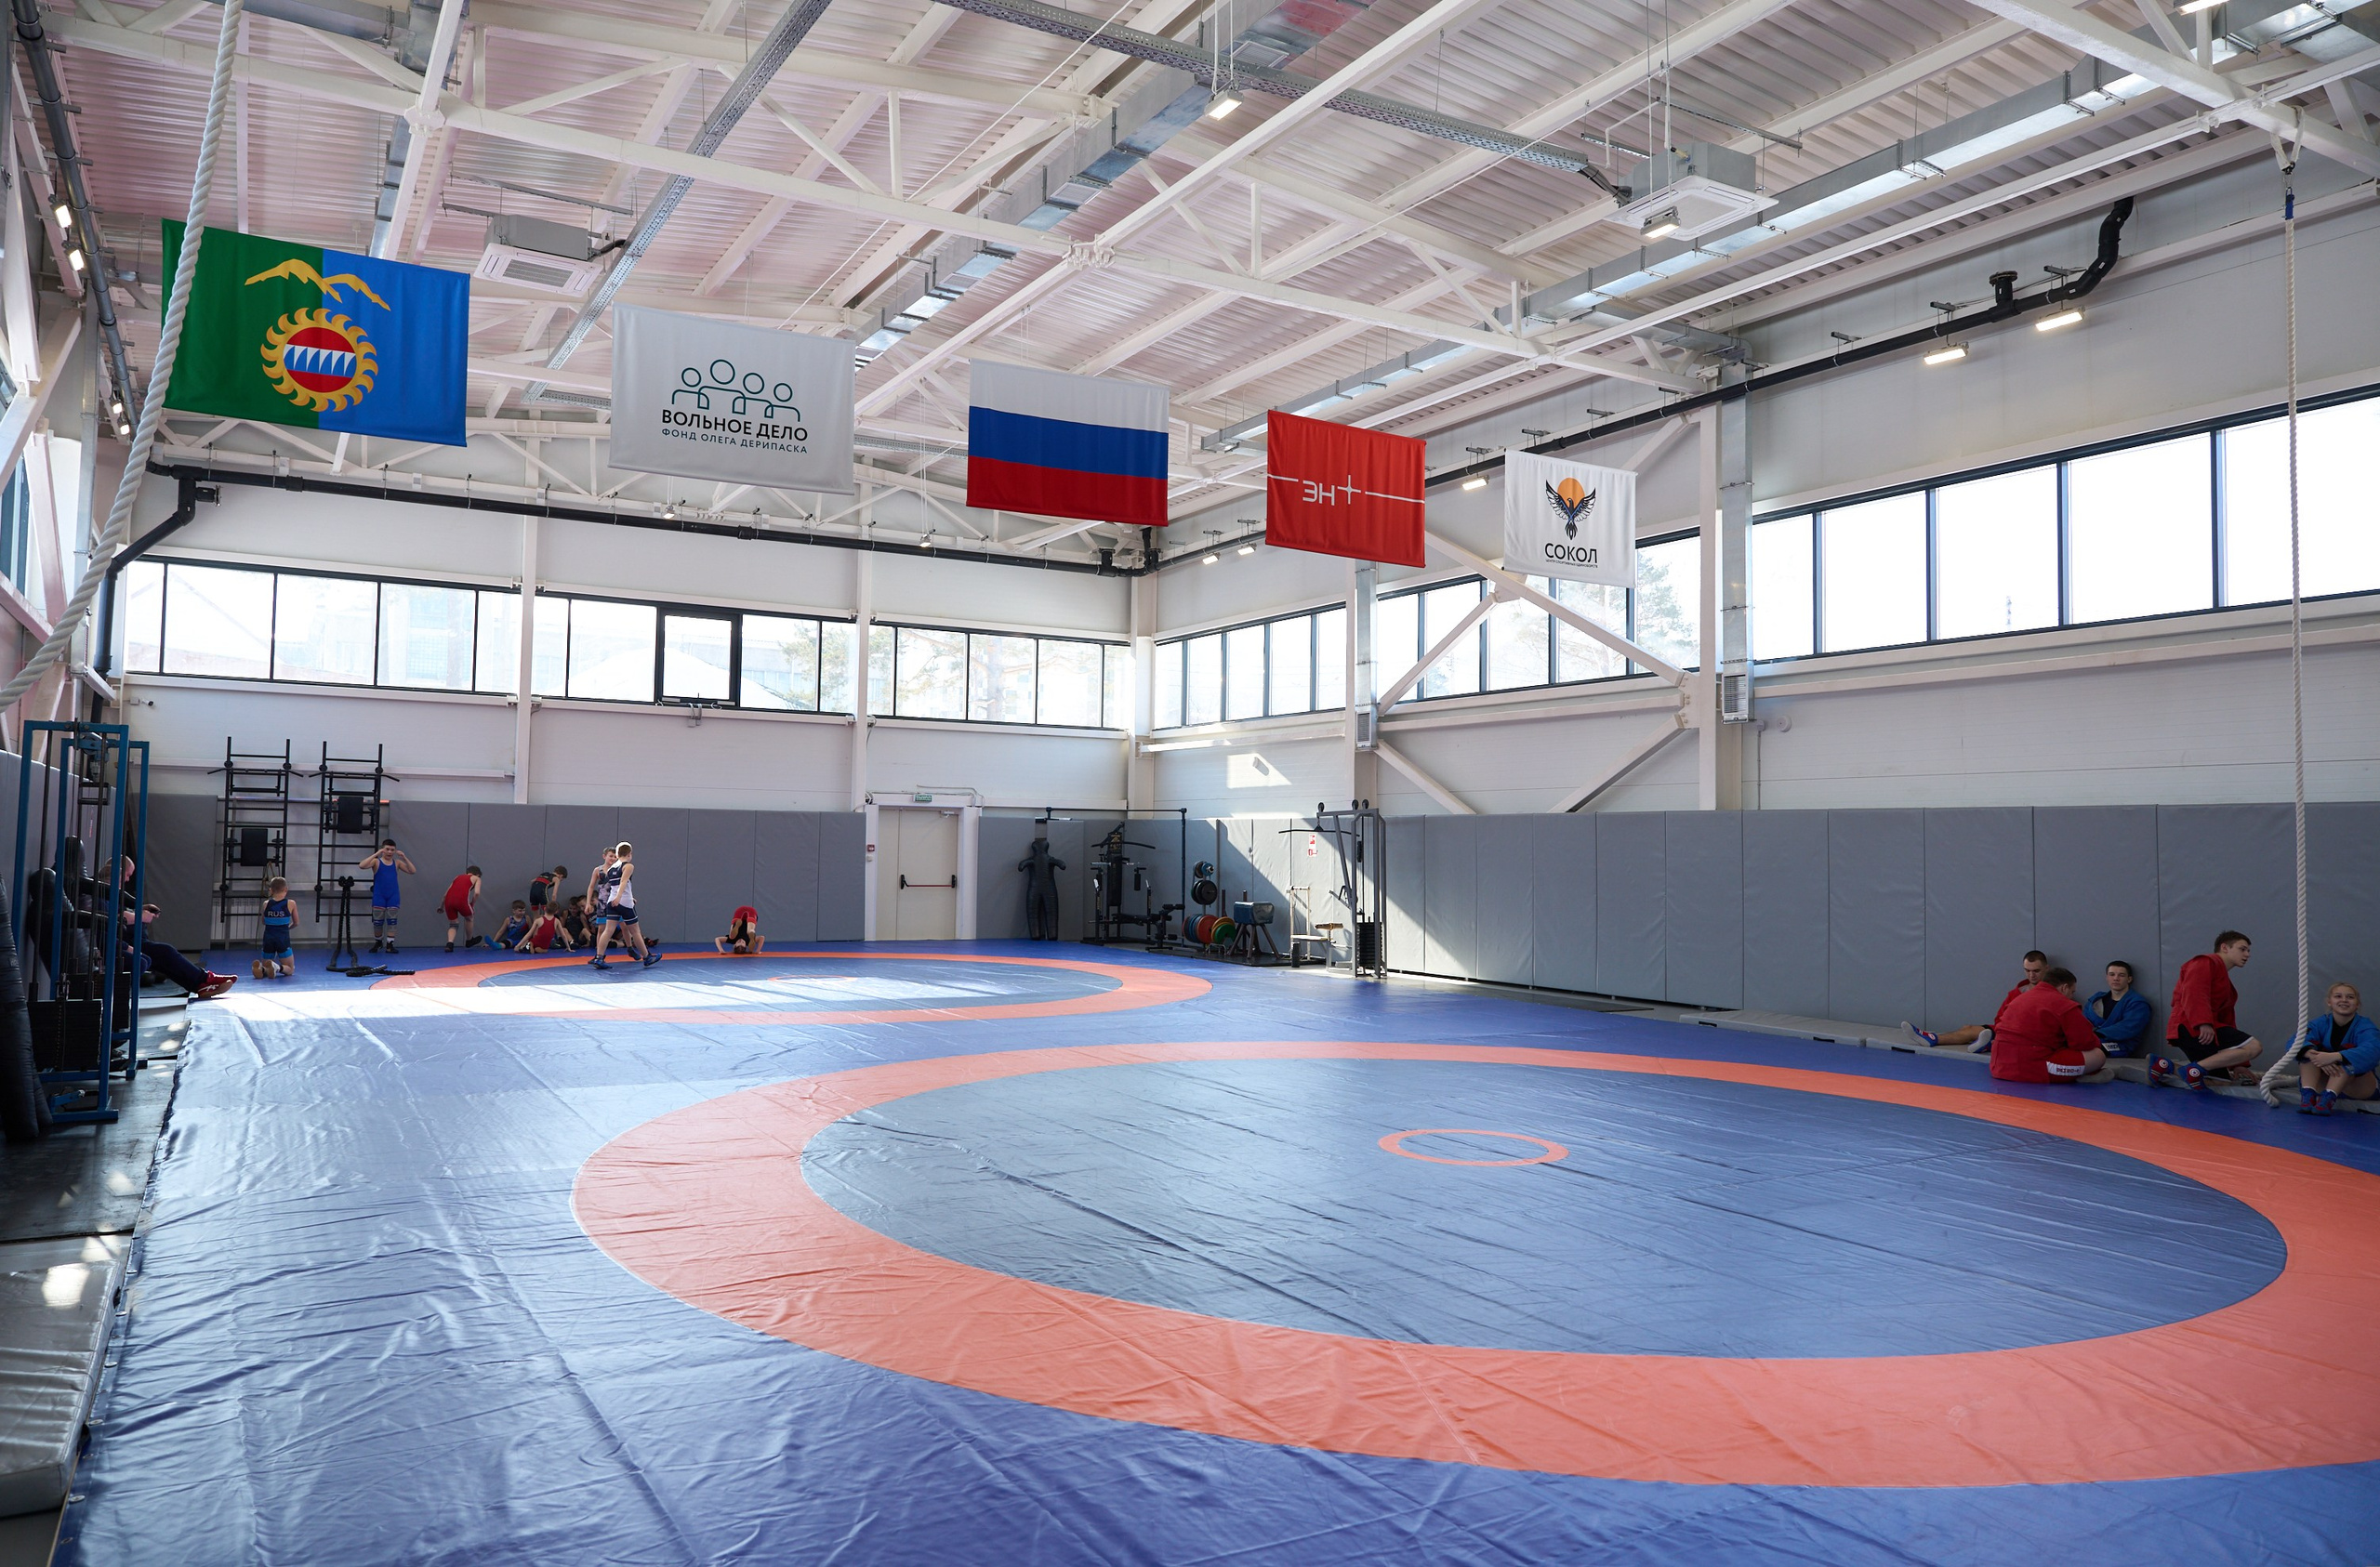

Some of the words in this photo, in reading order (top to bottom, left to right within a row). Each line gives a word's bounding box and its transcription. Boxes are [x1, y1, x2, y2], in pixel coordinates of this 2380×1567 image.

[661, 409, 752, 435] ВОЛЬНОЕ
[756, 423, 808, 441] ДЕЛО
[661, 428, 697, 441] ФОНД
[701, 433, 736, 445] ОЛЕГА
[740, 439, 808, 454] ДЕРИПАСКА
[1544, 543, 1597, 563] СОКОЛ
